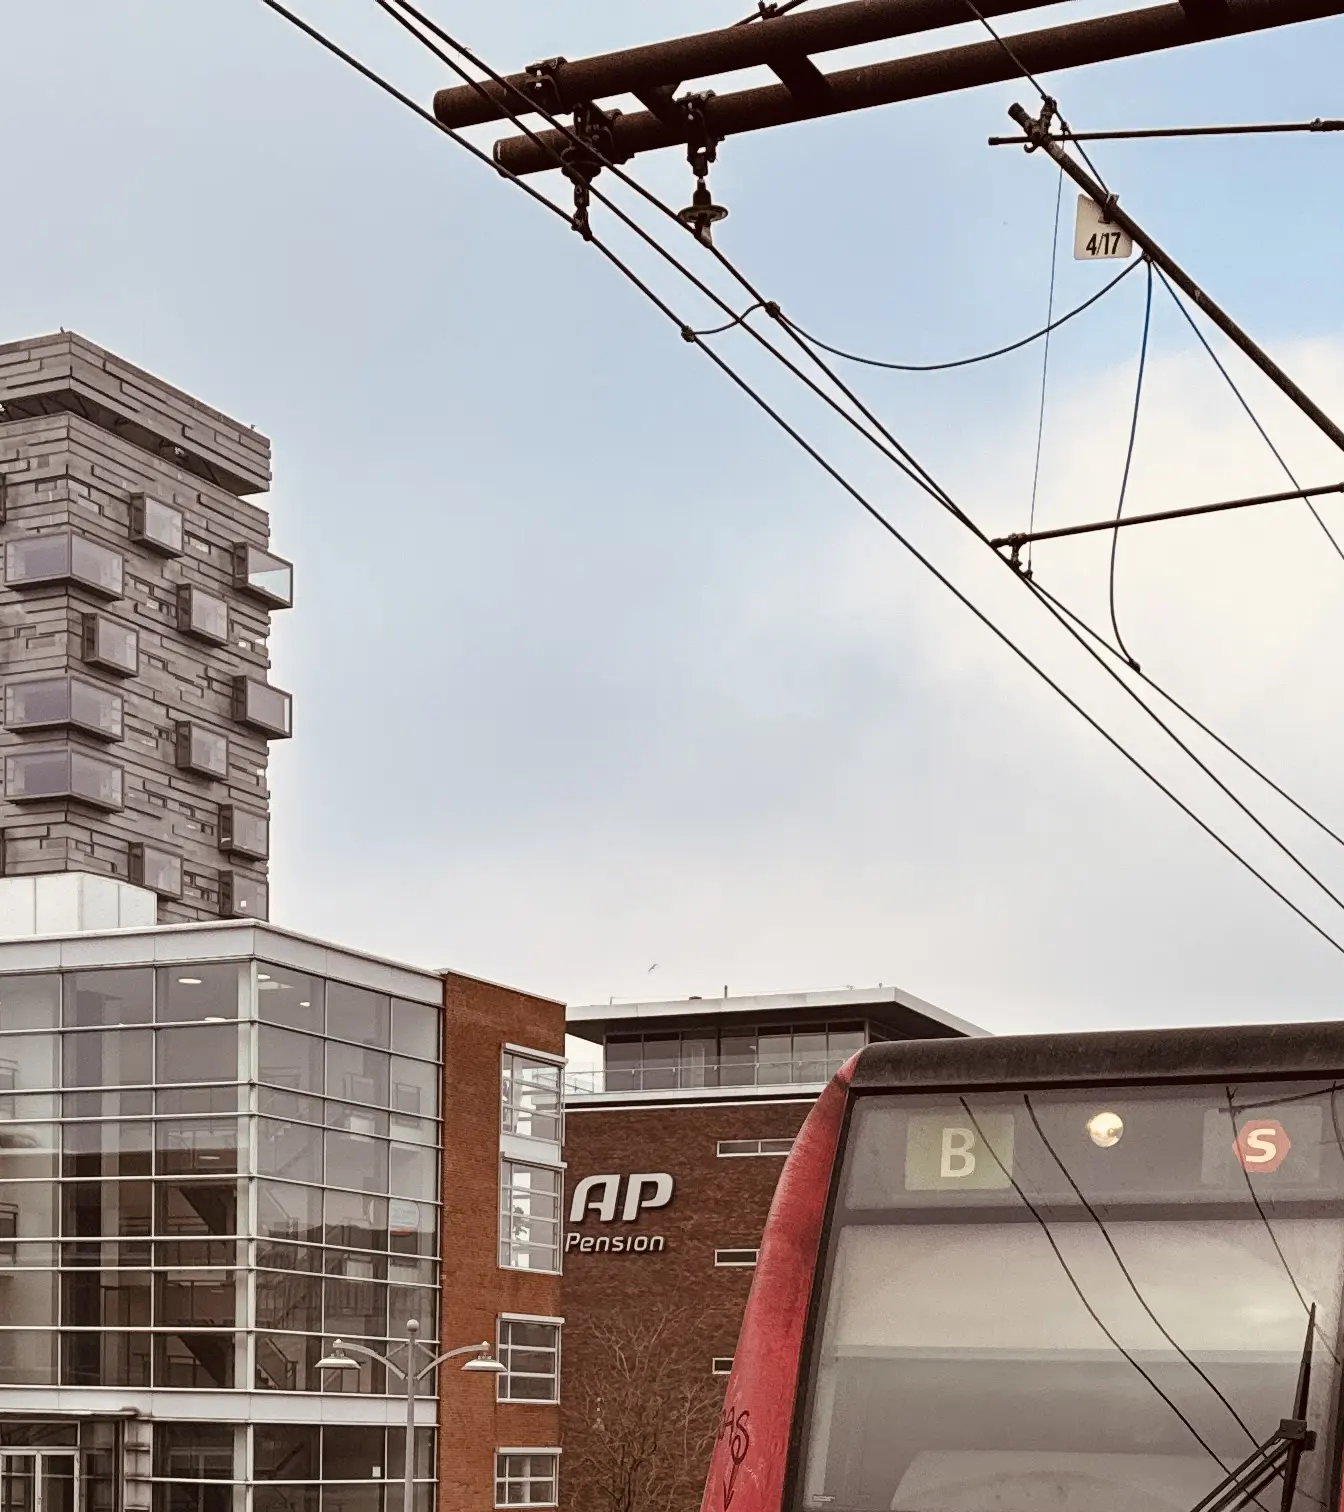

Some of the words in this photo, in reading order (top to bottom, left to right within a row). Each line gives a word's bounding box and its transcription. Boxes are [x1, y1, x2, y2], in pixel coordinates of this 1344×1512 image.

[1085, 231, 1122, 256] 4/17
[940, 1127, 976, 1178] B
[1245, 1128, 1277, 1163] S
[569, 1172, 674, 1222] AP
[564, 1232, 665, 1252] Pension
